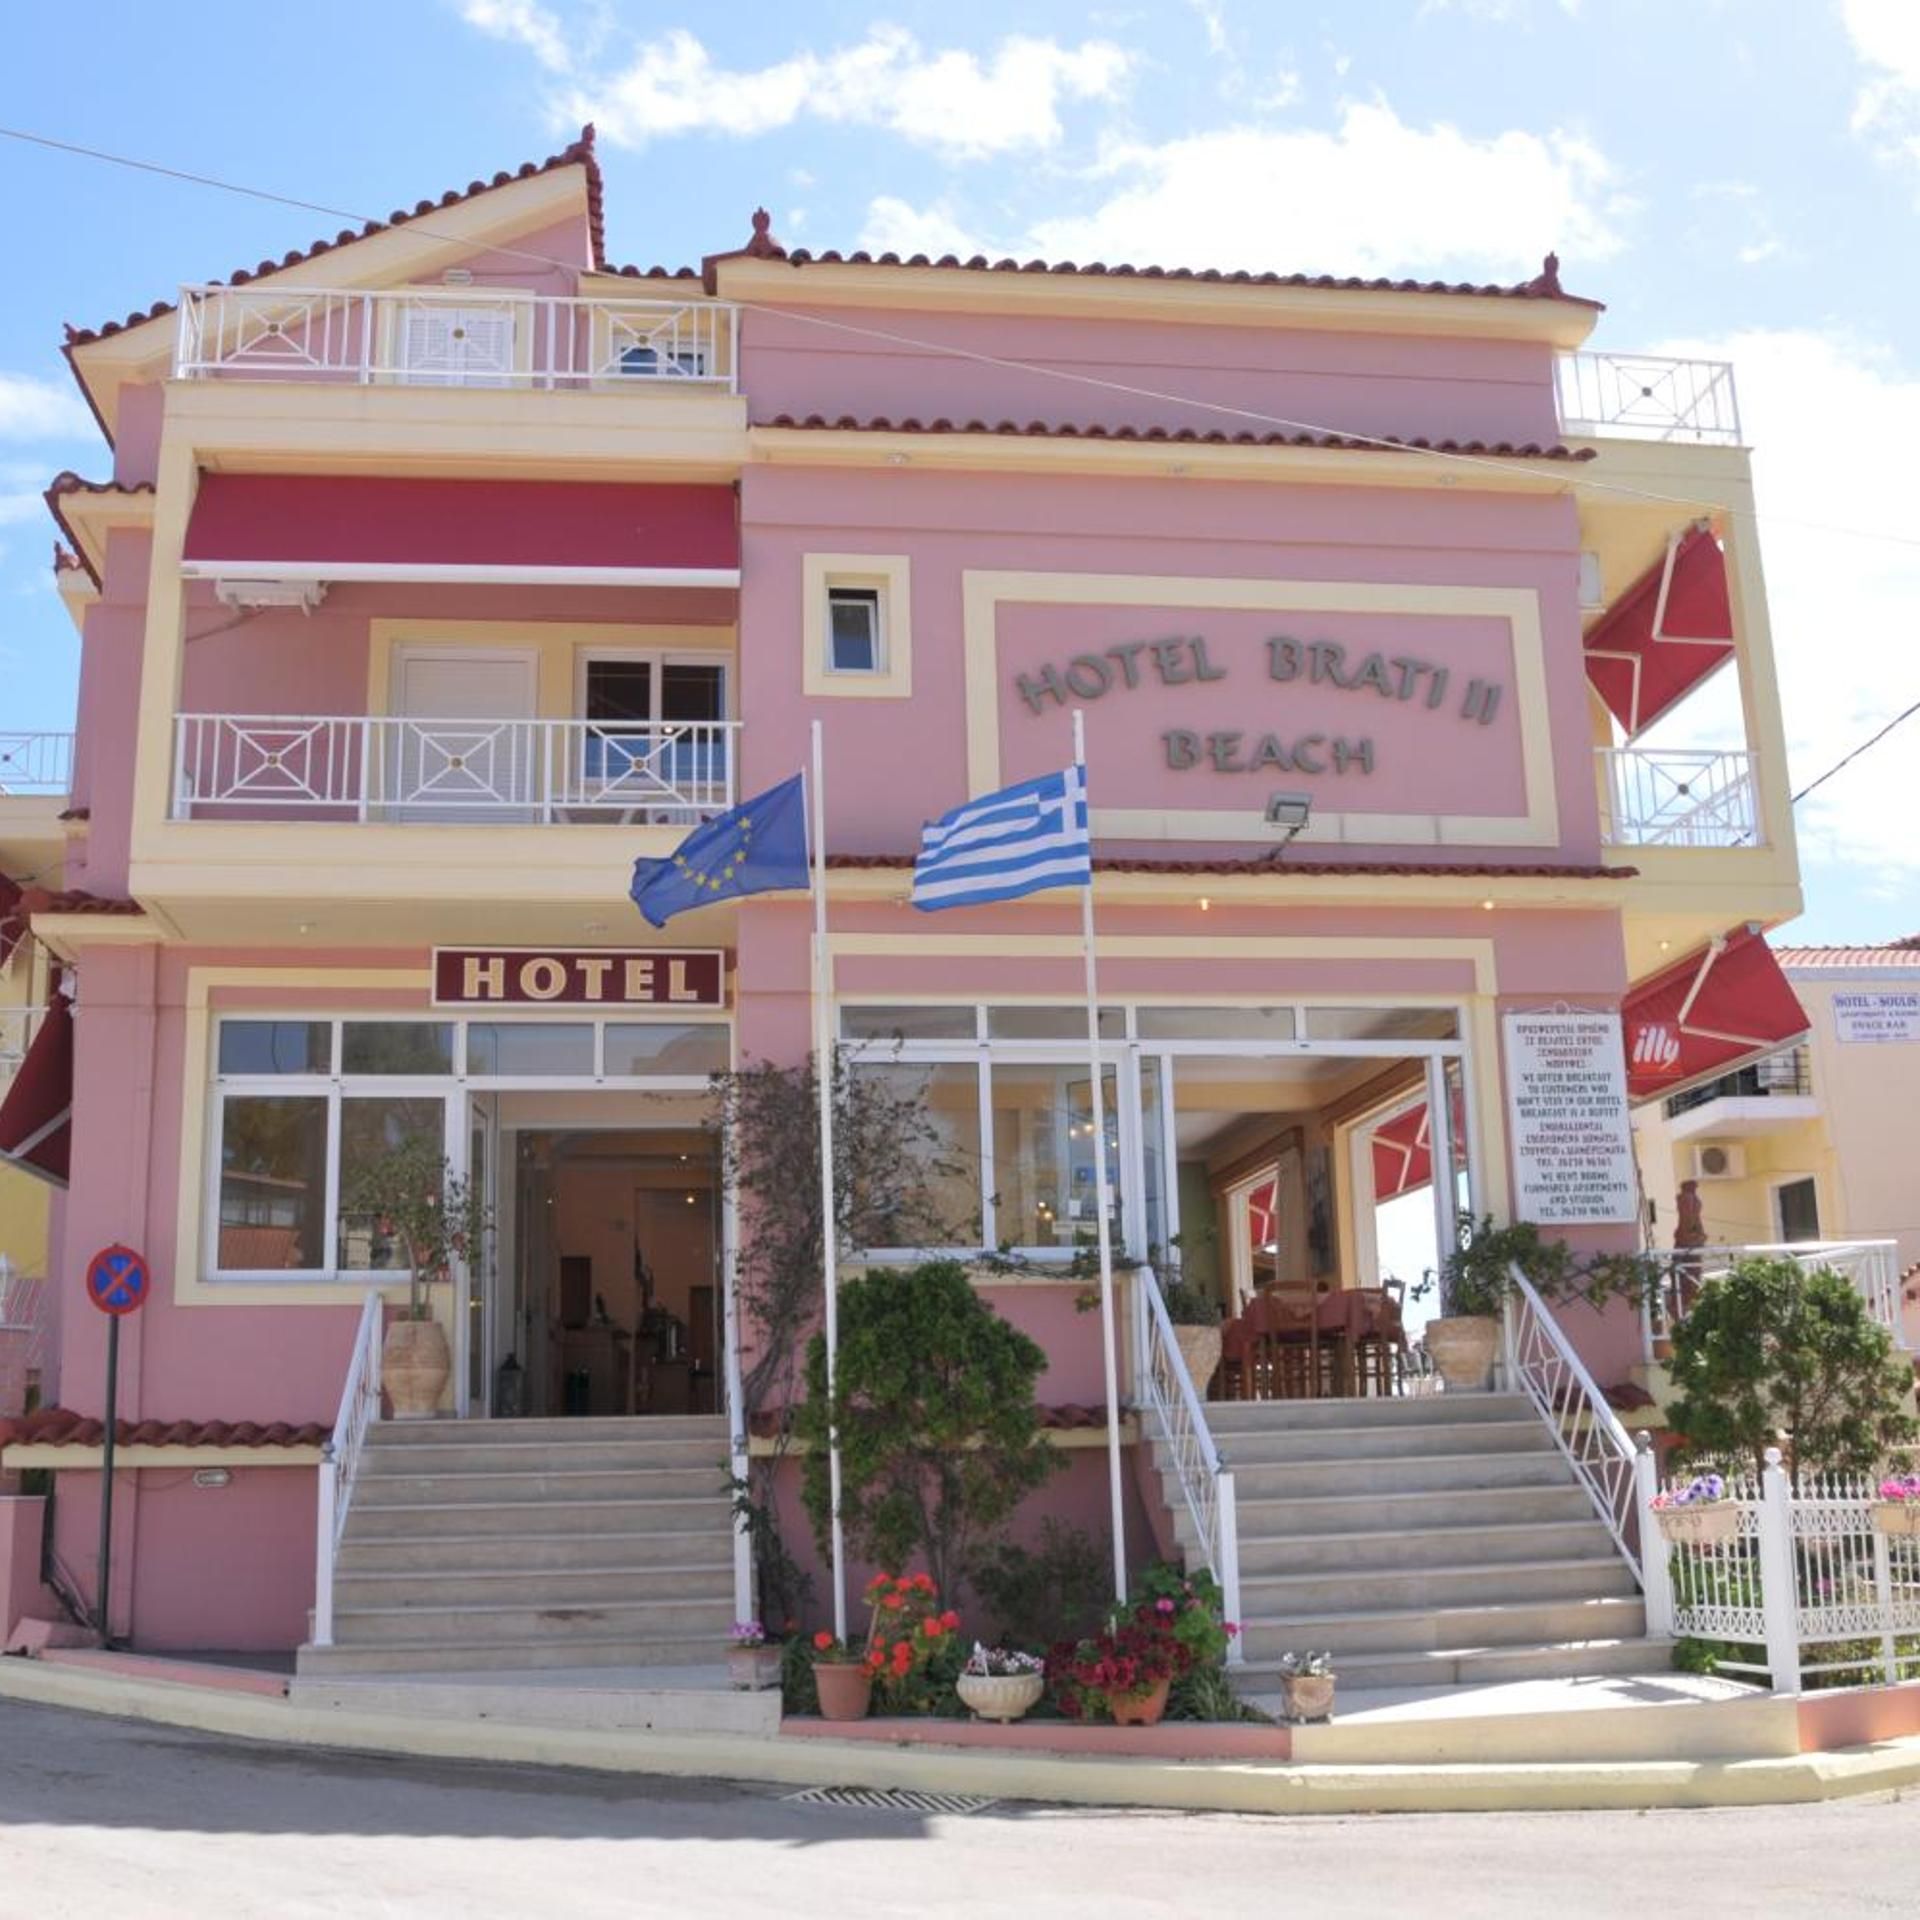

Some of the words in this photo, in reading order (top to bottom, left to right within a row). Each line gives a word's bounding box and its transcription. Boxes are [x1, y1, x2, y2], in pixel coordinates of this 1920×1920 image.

[1015, 635, 1229, 716] HOTEL
[1266, 636, 1449, 709] BRATI
[1161, 729, 1376, 775] BEACH
[463, 957, 698, 1000] HOTEL
[1835, 996, 1869, 1008] HOTEL
[1633, 1027, 1679, 1072] illy
[1522, 1073, 1534, 1083] WE
[1537, 1073, 1563, 1083] OFFER
[1566, 1072, 1611, 1083] BREAKFAST
[1527, 1085, 1539, 1095] TO
[1542, 1084, 1588, 1095] CUSTOMERS
[1591, 1084, 1609, 1094] WHO
[1596, 1096, 1621, 1105] HOTEL
[1520, 1108, 1567, 1118] BREAKFAST
[1589, 1107, 1619, 1117] BUFFET
[1556, 1172, 1578, 1182] RENT
[1581, 1171, 1609, 1181] ROOMS
[1573, 1182, 1628, 1193] APARTMENTS
